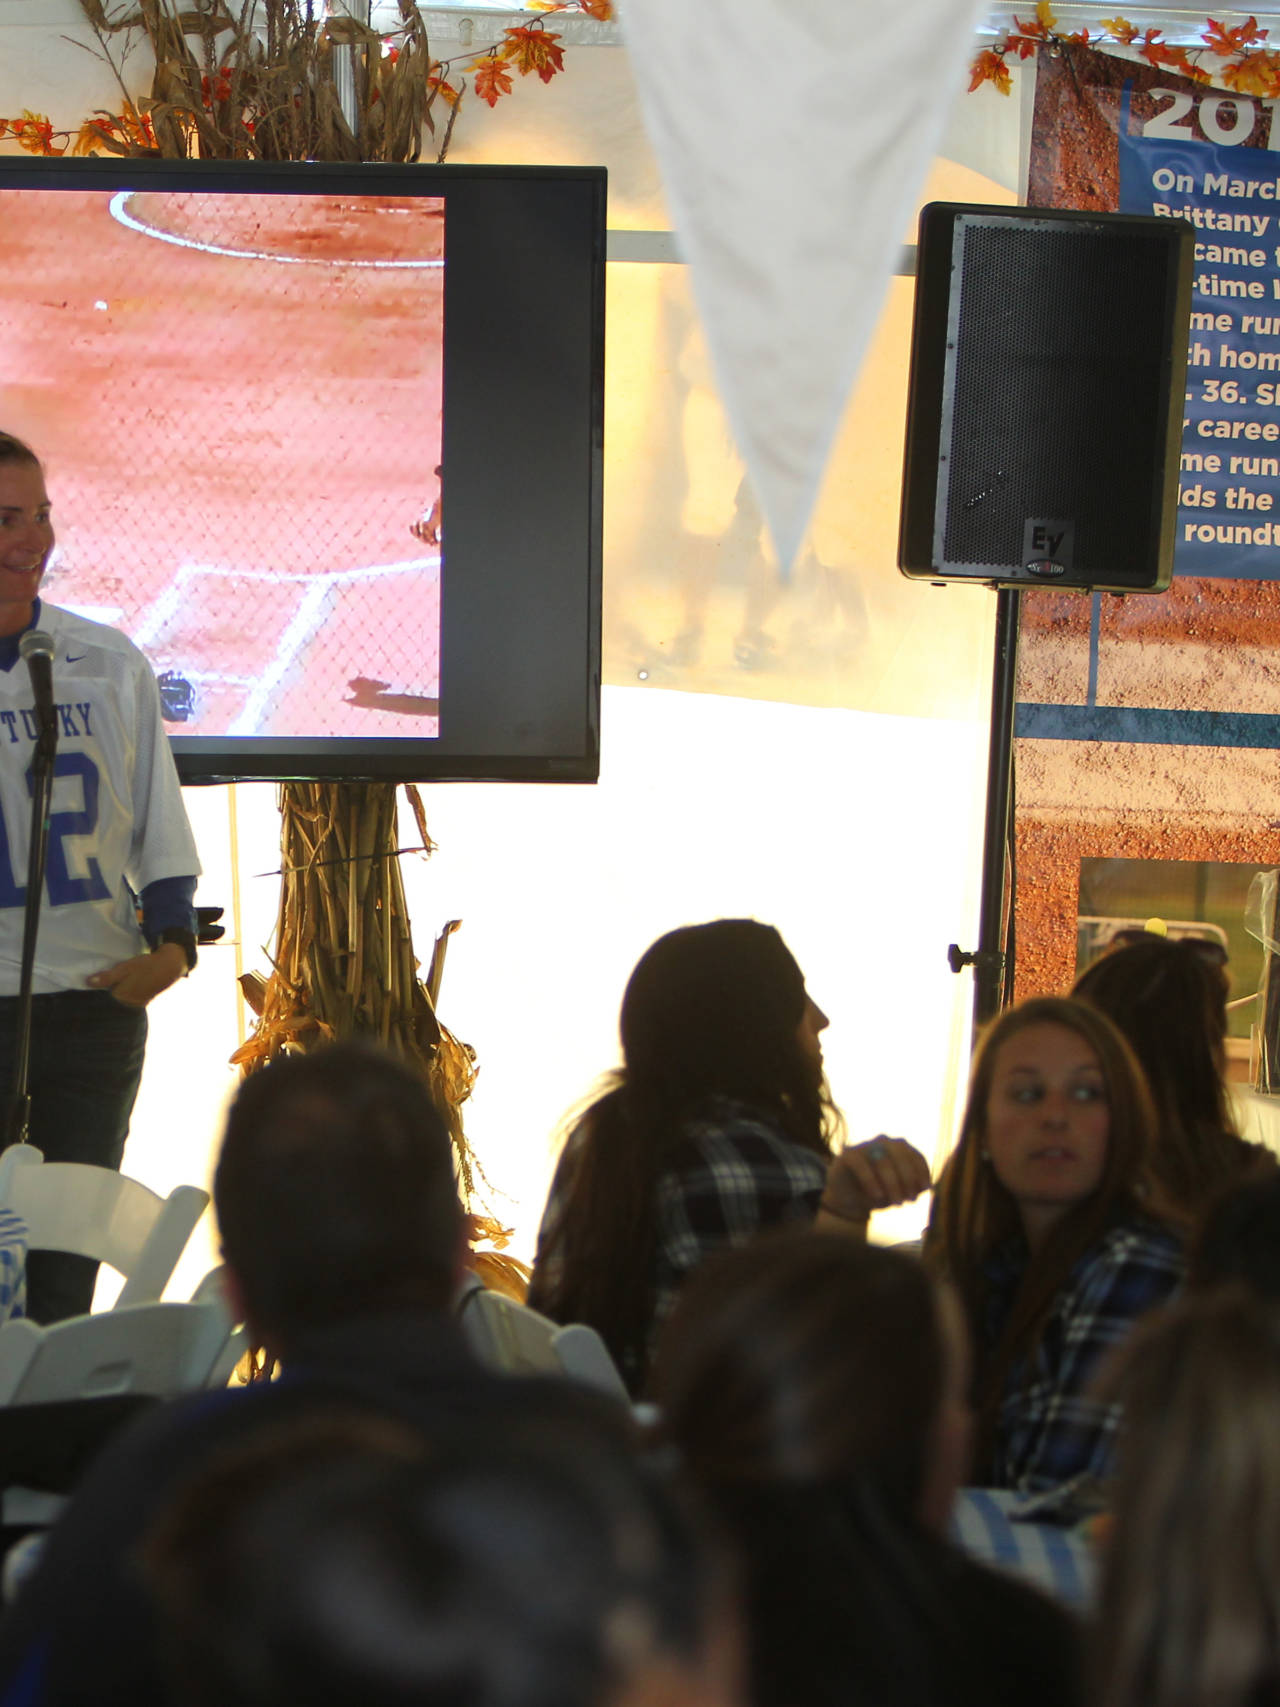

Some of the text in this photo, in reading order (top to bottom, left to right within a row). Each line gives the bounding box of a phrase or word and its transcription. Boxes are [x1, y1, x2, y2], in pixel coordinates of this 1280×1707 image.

[1152, 168, 1194, 193] On
[1152, 202, 1270, 237] Brittany
[1194, 242, 1267, 268] came
[1189, 312, 1233, 332] me
[1201, 379, 1247, 404] 36.
[1197, 419, 1280, 442] caree
[1180, 453, 1280, 477] me run
[1225, 486, 1273, 511] the
